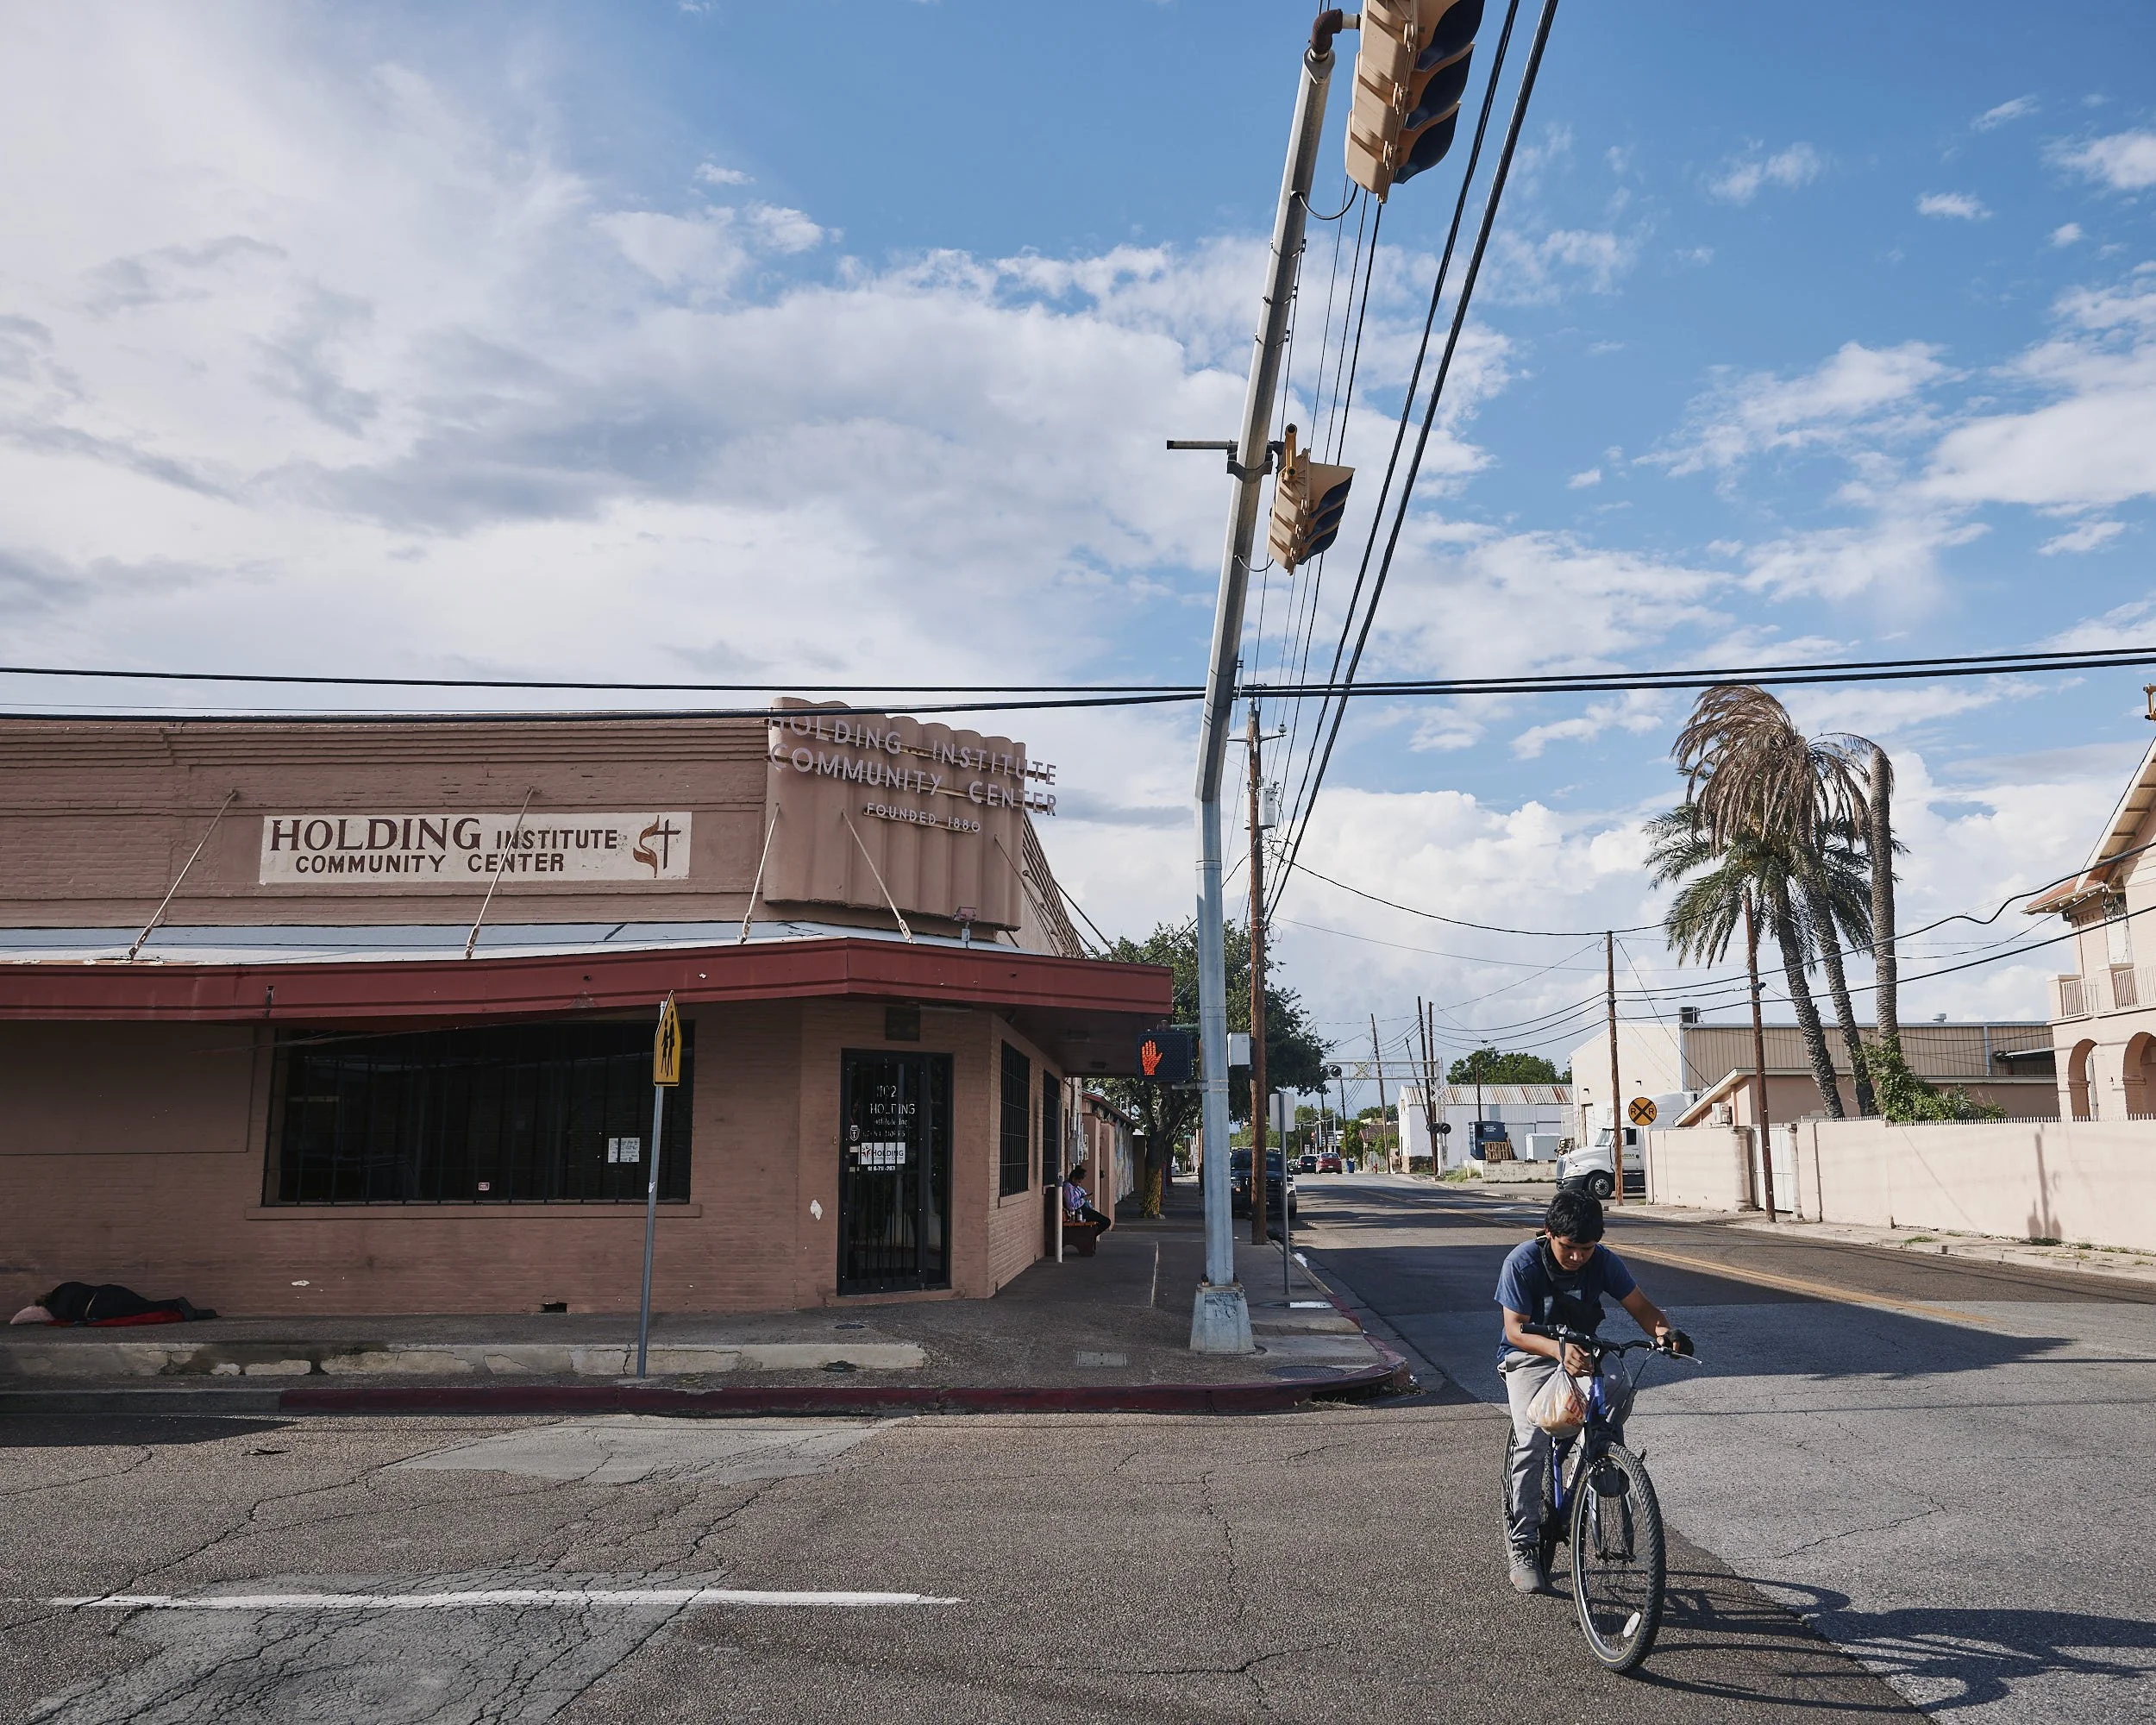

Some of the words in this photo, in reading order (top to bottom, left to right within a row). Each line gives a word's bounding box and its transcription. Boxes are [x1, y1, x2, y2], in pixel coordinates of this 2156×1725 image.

[932, 740, 1056, 786] INSTITUTE
[770, 743, 942, 795] COMMUNITY
[968, 781, 1056, 817] CENTER
[866, 802, 937, 825] FOUNDED
[948, 816, 981, 832] 1880
[270, 818, 481, 851] HOLDING
[496, 829, 617, 850] INSTITUTE
[295, 854, 447, 874] COMMUNITY
[467, 853, 564, 873] CENTER
